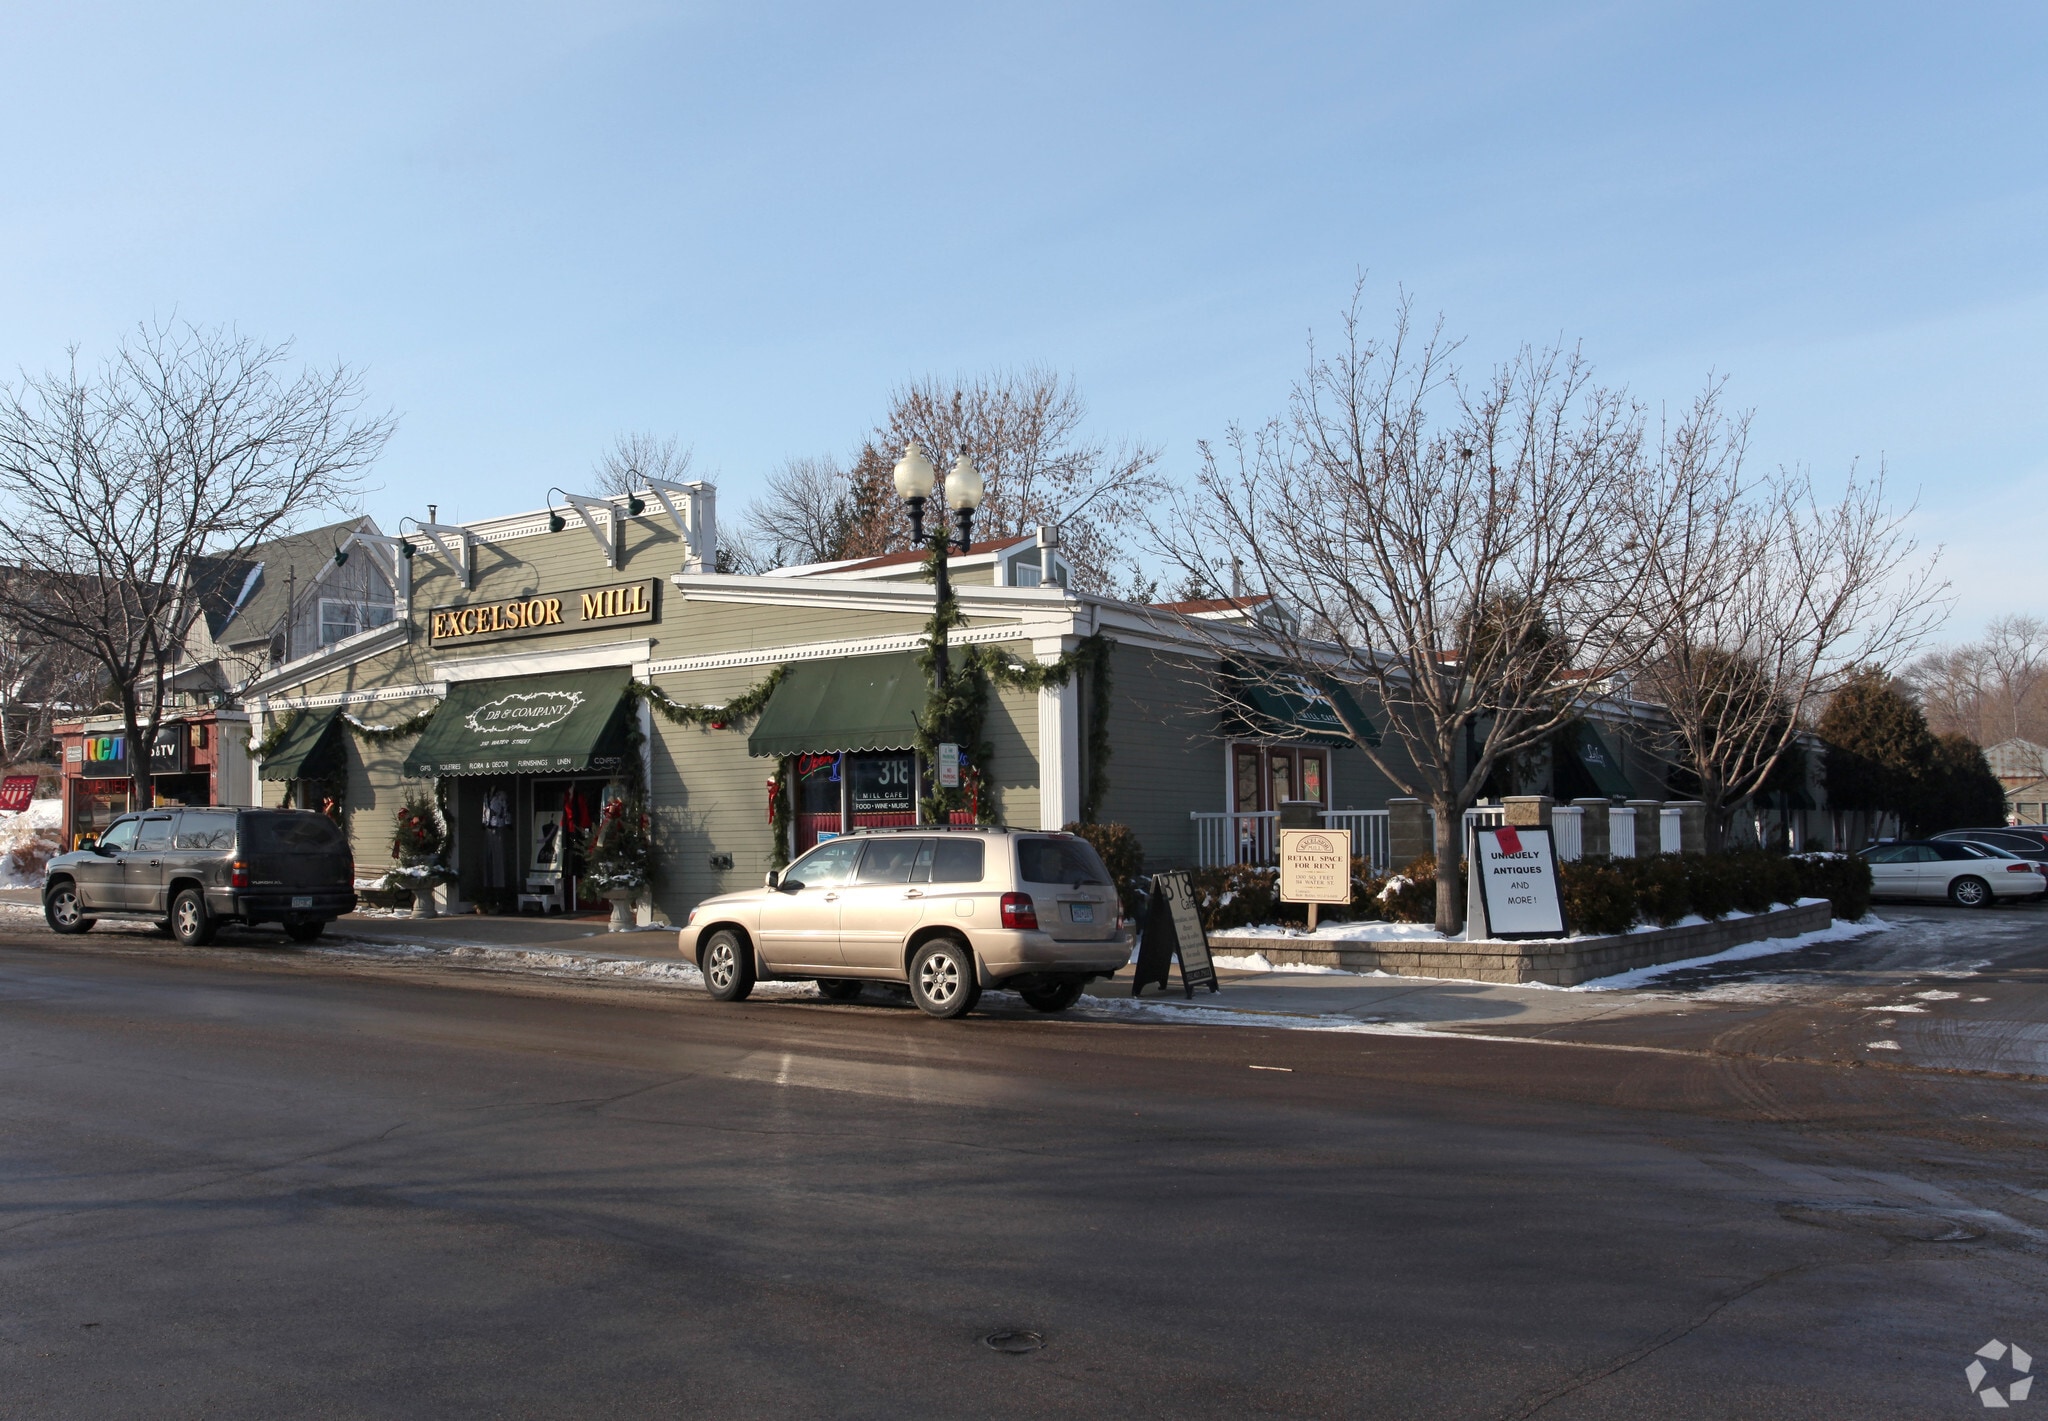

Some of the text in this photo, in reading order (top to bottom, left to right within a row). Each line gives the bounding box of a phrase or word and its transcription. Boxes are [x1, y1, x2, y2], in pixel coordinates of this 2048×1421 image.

[432, 585, 649, 639] EXCELSIOR MILL
[484, 704, 567, 721] DB & COMPANY
[83, 737, 125, 760] RCA
[469, 761, 484, 770] FLORA
[517, 759, 548, 768] FURNISHINGS
[557, 758, 571, 766] LINEN
[798, 752, 834, 777] Open
[878, 760, 908, 785] 318
[1494, 866, 1541, 874] ANTIQUES
